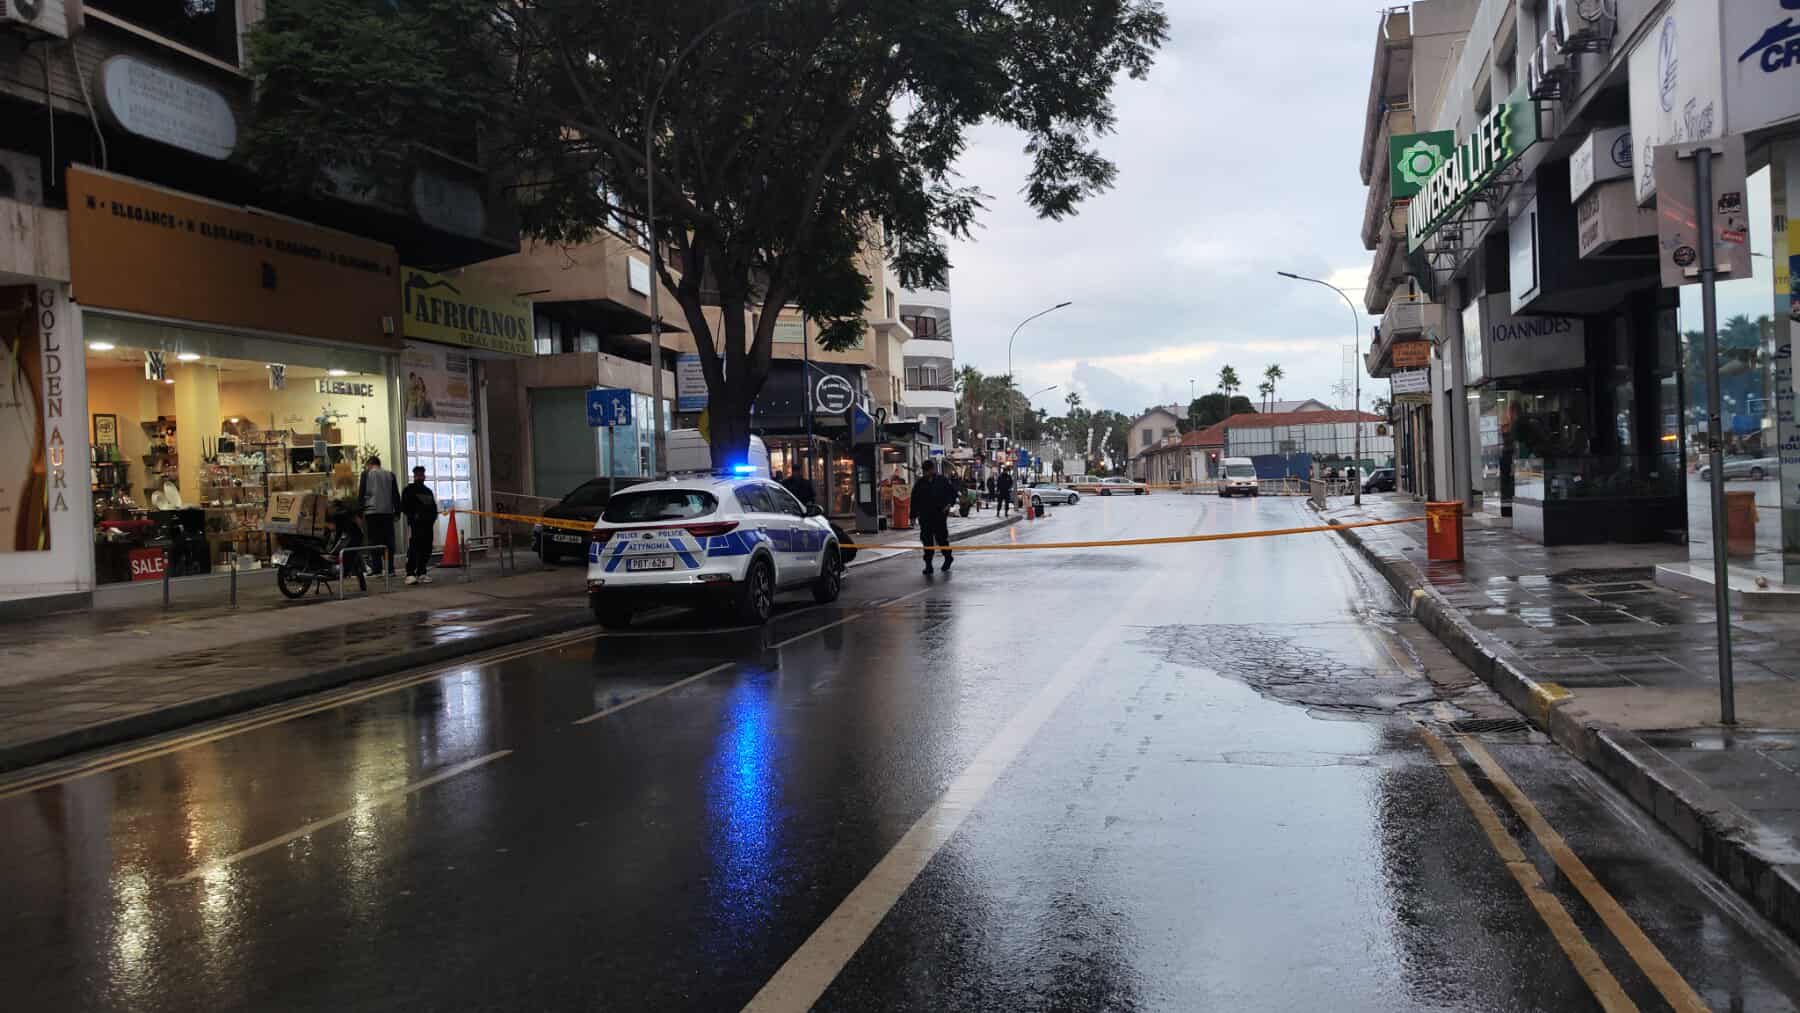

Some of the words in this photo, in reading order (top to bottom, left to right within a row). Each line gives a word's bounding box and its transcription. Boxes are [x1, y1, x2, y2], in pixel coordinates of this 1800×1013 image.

[1408, 144, 1468, 239] UNIVERSAL
[1469, 104, 1502, 180] LIFE
[112, 200, 176, 229] ELEGANCE
[416, 294, 527, 341] AFRICANOS
[1492, 316, 1571, 344] IOANNIDES
[39, 288, 63, 418] GOLDEN
[319, 380, 374, 397] ELEGANCE
[49, 423, 69, 512] AURA
[131, 557, 164, 575] SALE
